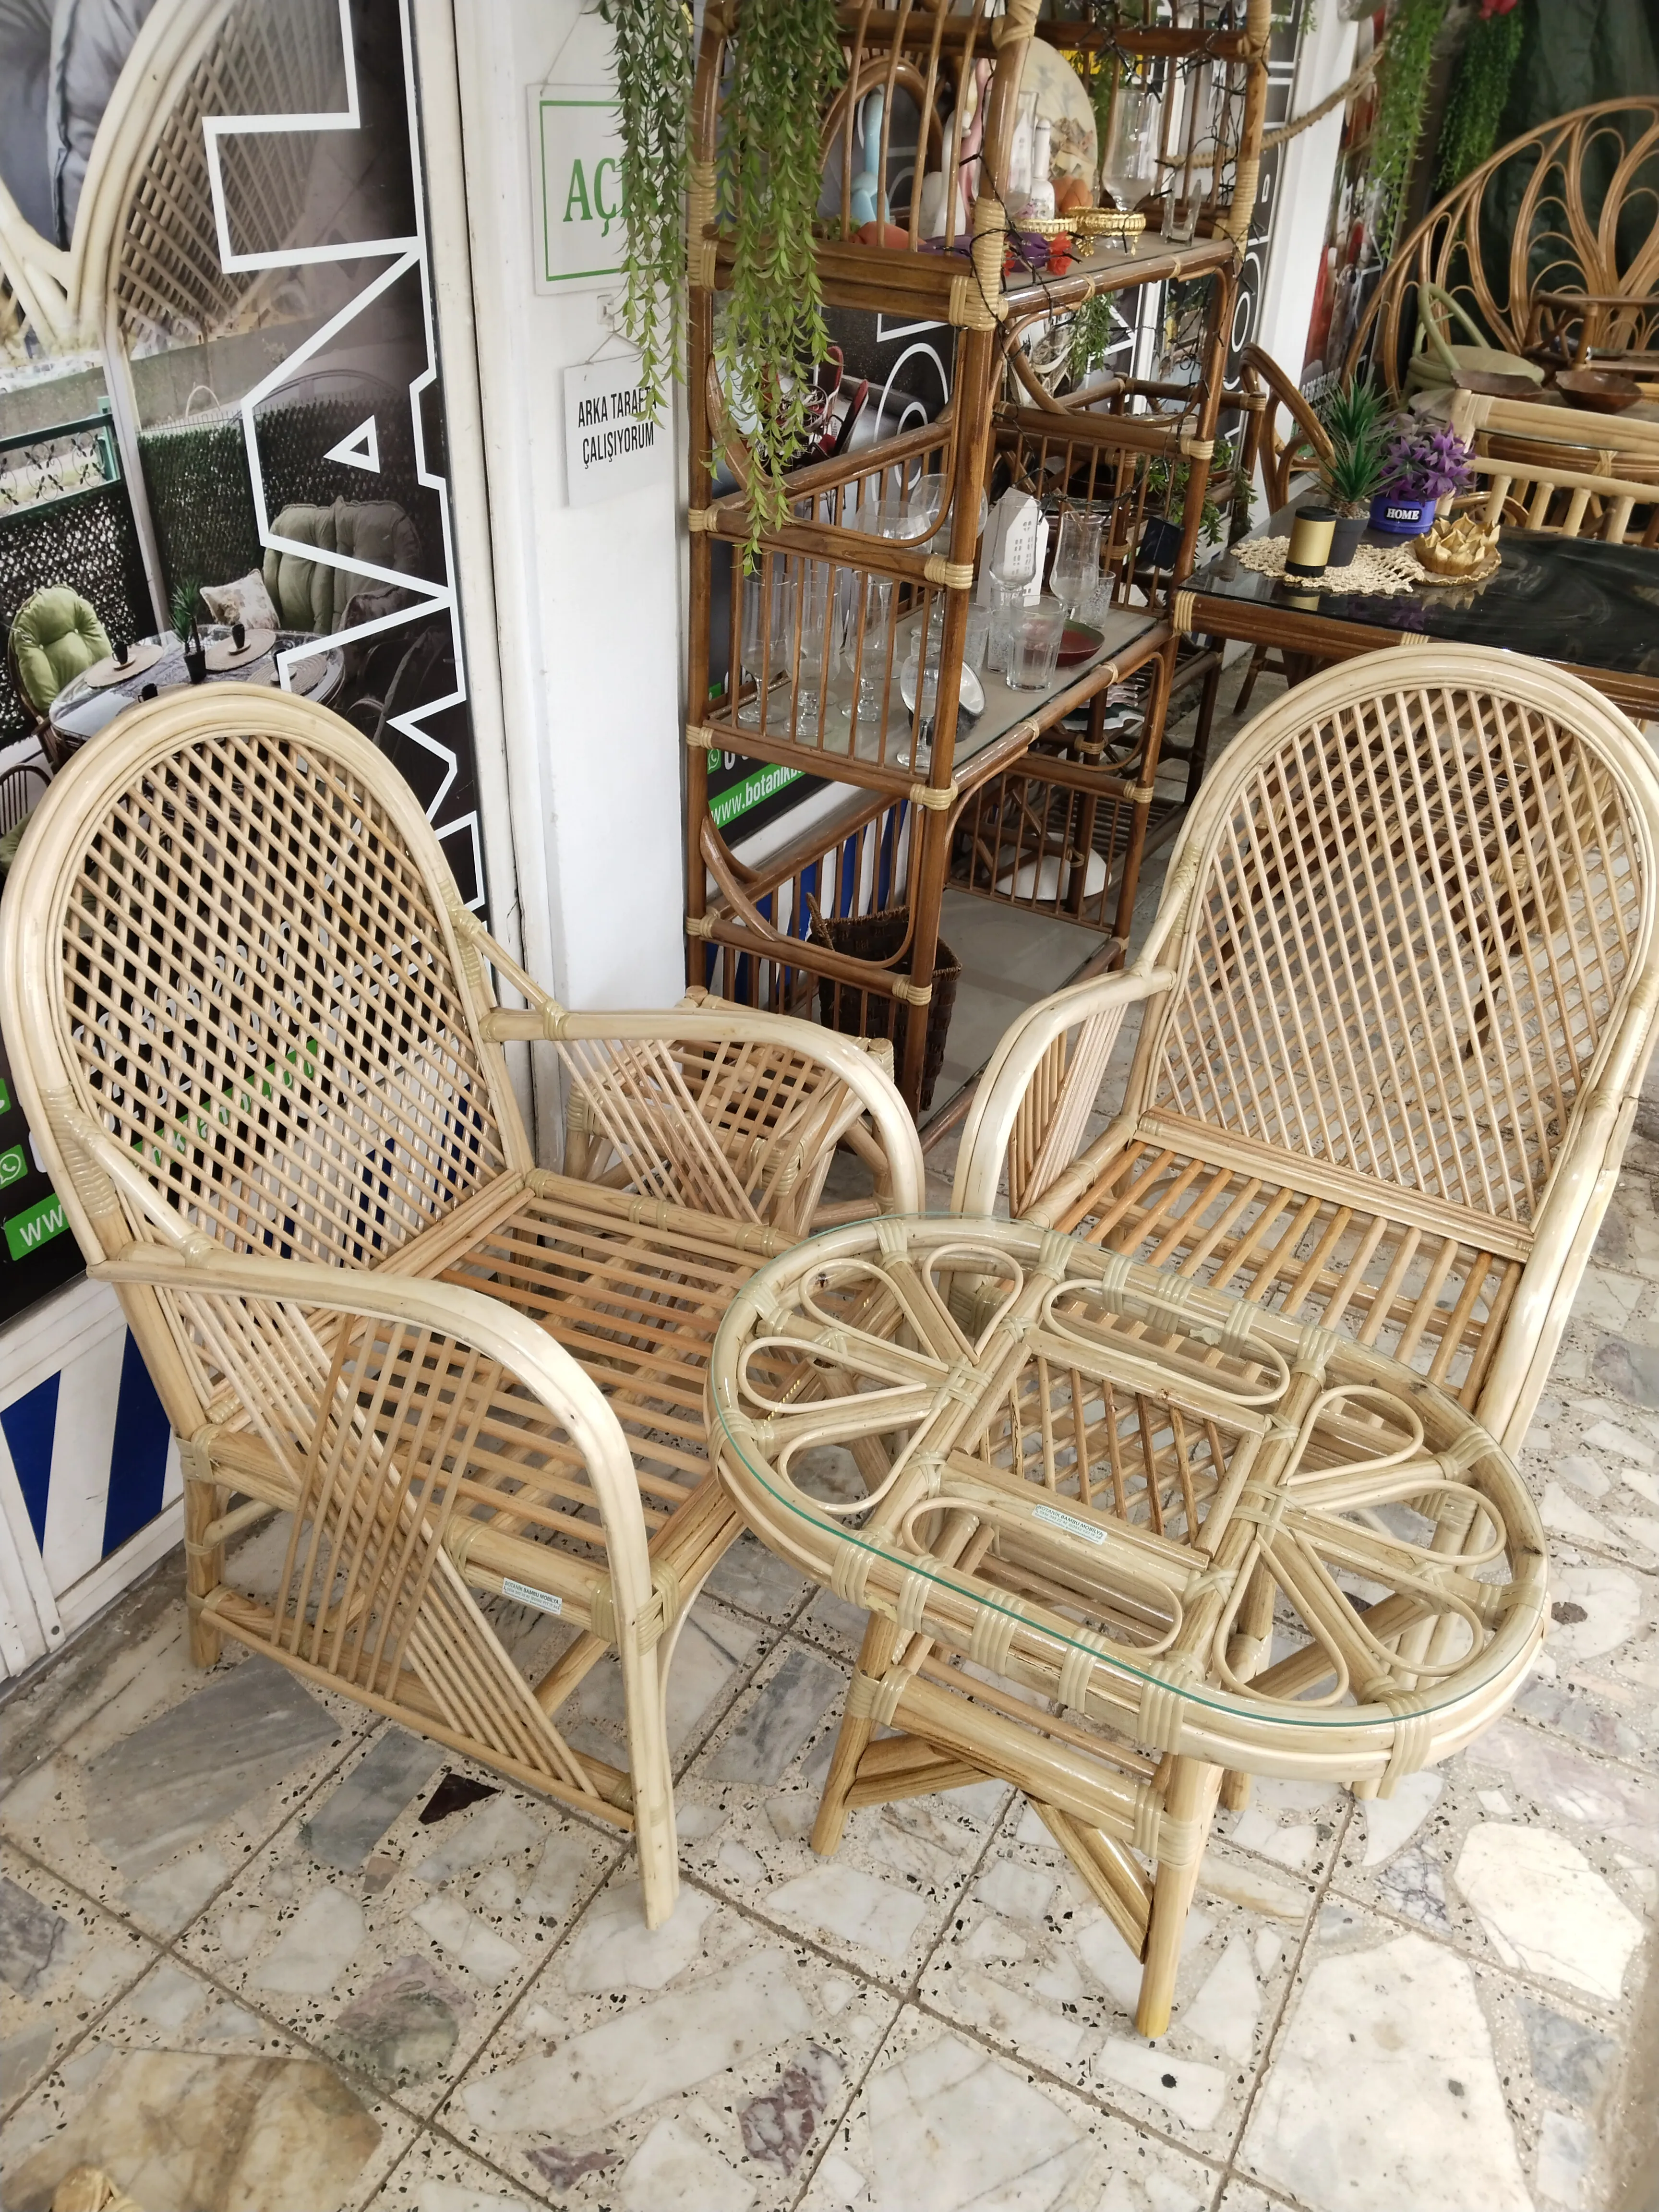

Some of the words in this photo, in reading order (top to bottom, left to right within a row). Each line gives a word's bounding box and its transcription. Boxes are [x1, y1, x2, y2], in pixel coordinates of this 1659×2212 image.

[563, 156, 668, 238] AÇI
[578, 396, 608, 428] ARKA
[582, 421, 654, 469] ÇALIŞIYORUM
[1386, 508, 1419, 520] HOME
[711, 765, 801, 825] www.botanik
[1061, 1515, 1080, 1526] BAMBU
[523, 1587, 539, 1598] BAMBU
[540, 1593, 559, 1605] MOBİLYA
